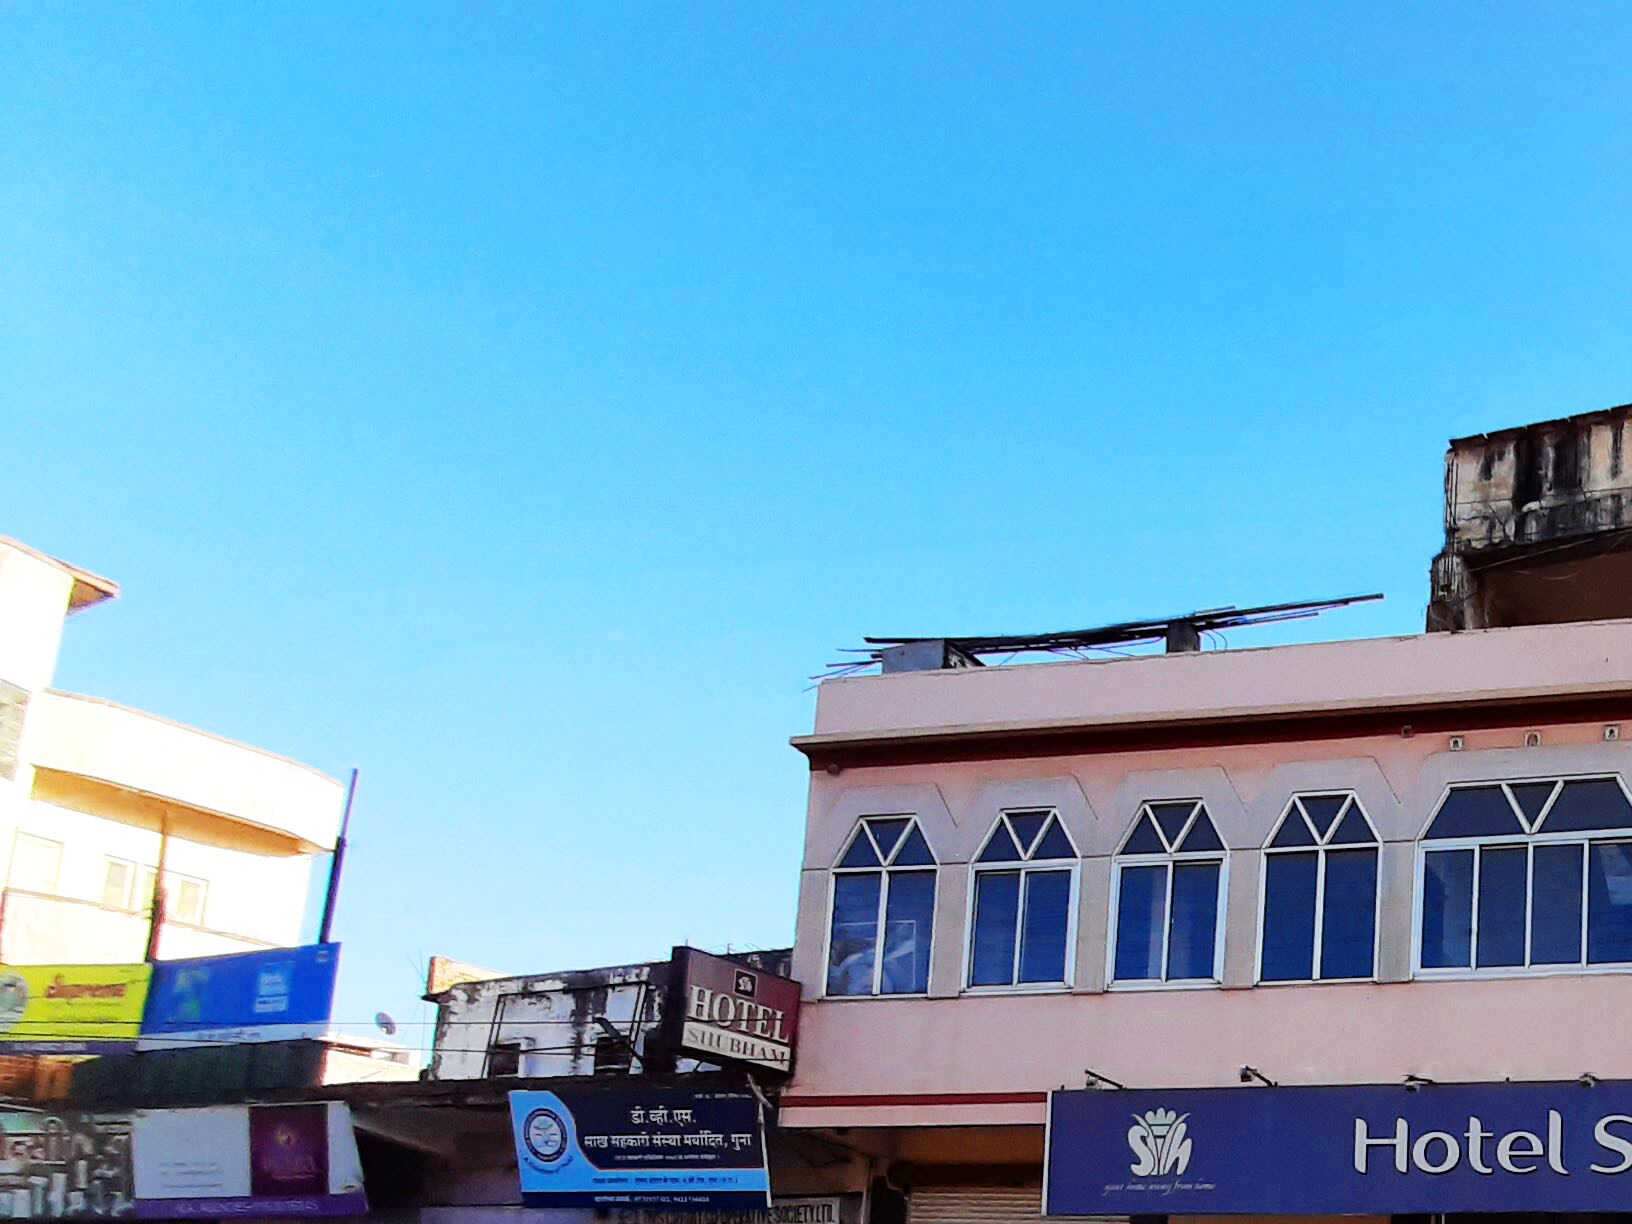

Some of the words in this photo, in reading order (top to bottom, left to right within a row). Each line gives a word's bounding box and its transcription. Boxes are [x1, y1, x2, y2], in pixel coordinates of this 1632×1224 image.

[687, 984, 790, 1044] HOTEL
[687, 1027, 787, 1067] SHUBHAM
[1354, 1108, 1570, 1176] Hotel
